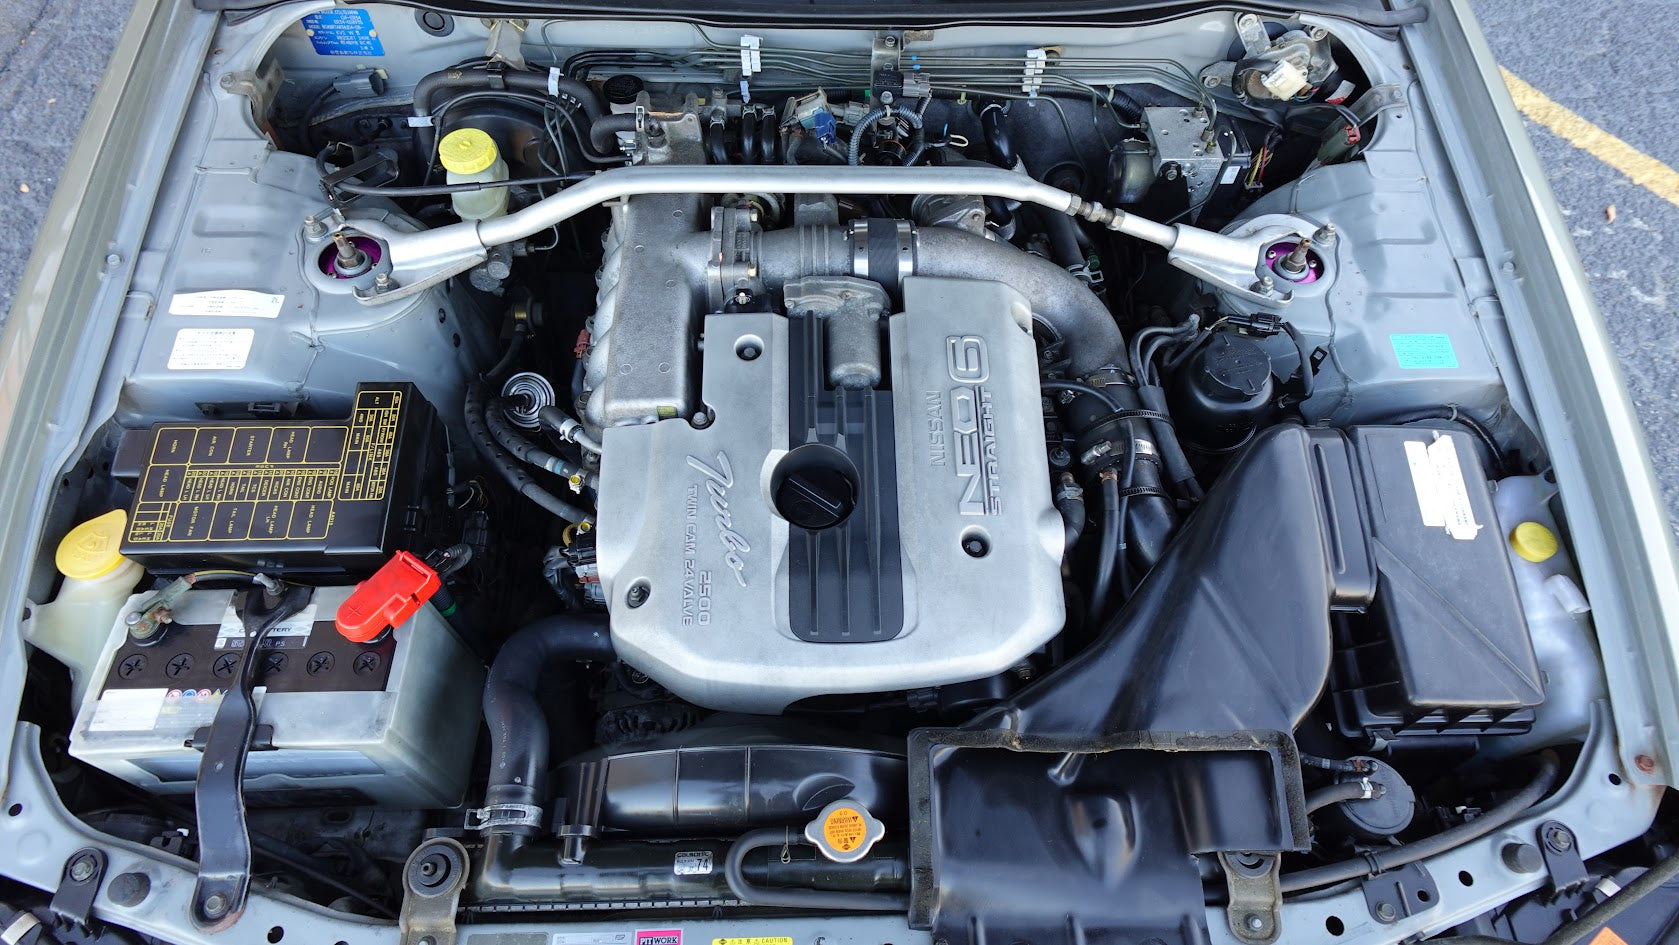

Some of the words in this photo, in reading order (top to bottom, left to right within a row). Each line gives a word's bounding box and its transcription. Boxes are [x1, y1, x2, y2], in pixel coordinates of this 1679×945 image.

[926, 390, 946, 466] NISSAN
[246, 435, 255, 456] STARTER
[981, 386, 1000, 515] STRAIGHT
[162, 469, 170, 482] HEAD
[158, 484, 166, 497] LAMP
[686, 484, 698, 519] TWIN
[190, 506, 199, 524] MOTOR
[686, 450, 750, 588] Turbo
[187, 526, 195, 537] FAN
[684, 522, 696, 554] CAM
[698, 570, 712, 626] 2500
[697, 859, 708, 871] 74
